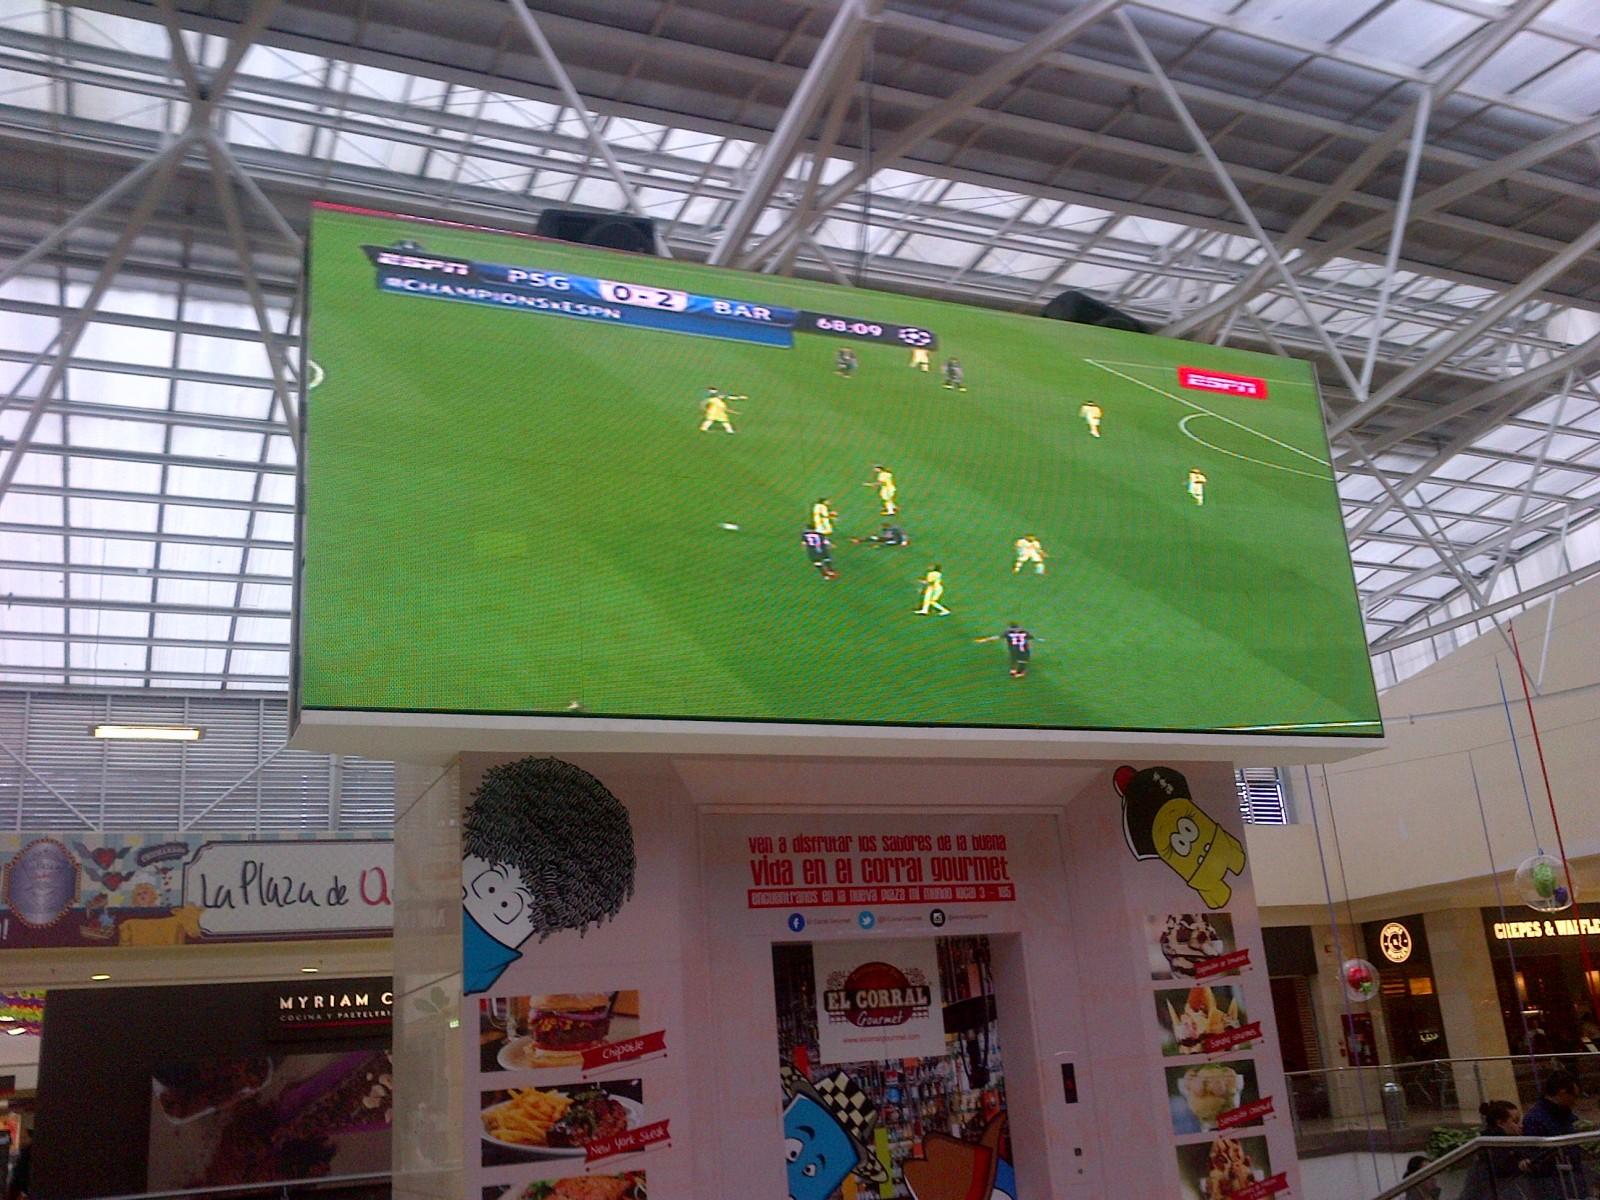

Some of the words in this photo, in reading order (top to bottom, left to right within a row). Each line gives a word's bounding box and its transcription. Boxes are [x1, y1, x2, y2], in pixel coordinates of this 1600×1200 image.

[377, 252, 470, 275] ESPN
[507, 269, 571, 291] PSG
[713, 301, 771, 321] BAR
[816, 317, 883, 337] 68:09
[1187, 373, 1257, 394] ESPN
[749, 835, 773, 854] ven
[779, 836, 787, 854] a
[881, 834, 932, 852] sabores
[937, 834, 952, 851] de
[957, 834, 968, 851] la
[972, 834, 1007, 851] buena
[750, 854, 795, 886] vida
[802, 858, 828, 885] en
[835, 857, 853, 884] el
[861, 856, 923, 884] corral
[930, 856, 1011, 882] gourmet
[201, 874, 235, 909] La
[240, 860, 320, 908] Plaza
[328, 875, 350, 907] de
[1493, 921, 1543, 940] CREPES
[1543, 920, 1556, 937] &
[279, 993, 369, 1010] MYRIAM
[827, 991, 851, 1011] EL
[855, 986, 929, 1009] CORRAL
[856, 1010, 903, 1027] Gourmet
